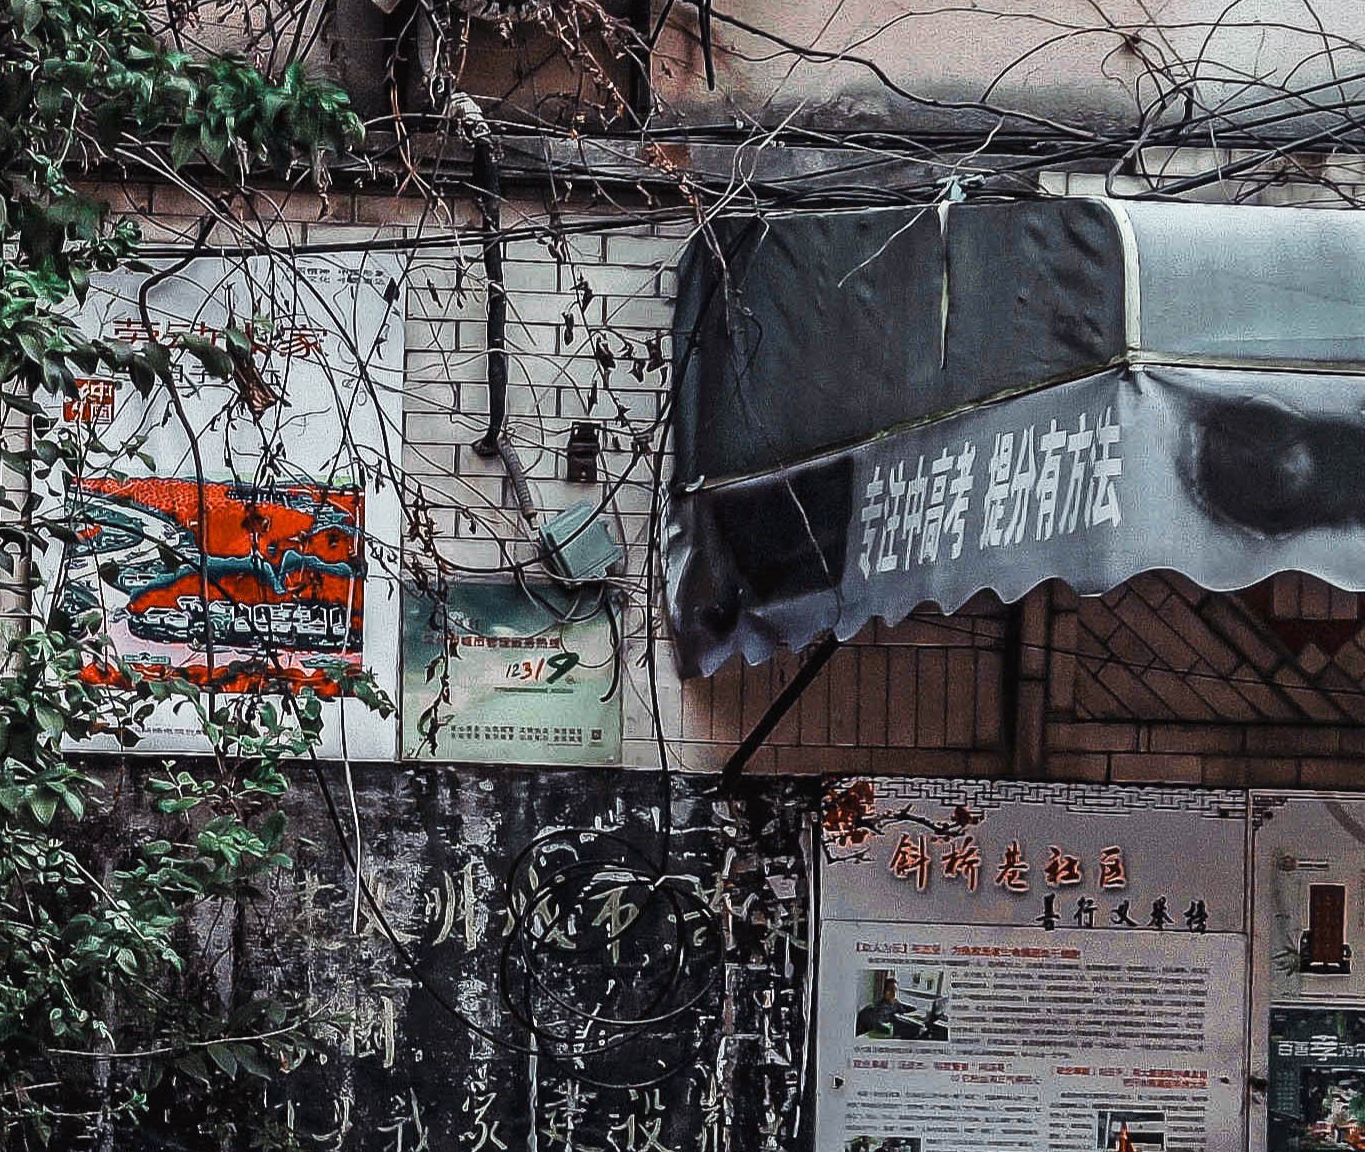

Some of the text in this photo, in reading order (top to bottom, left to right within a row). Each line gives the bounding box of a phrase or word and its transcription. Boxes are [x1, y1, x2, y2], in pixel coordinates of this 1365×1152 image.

[858, 404, 1125, 581] 专注中高考 提分有方法
[505, 652, 580, 685] 12319
[889, 832, 1127, 893] 斜桥巷社区
